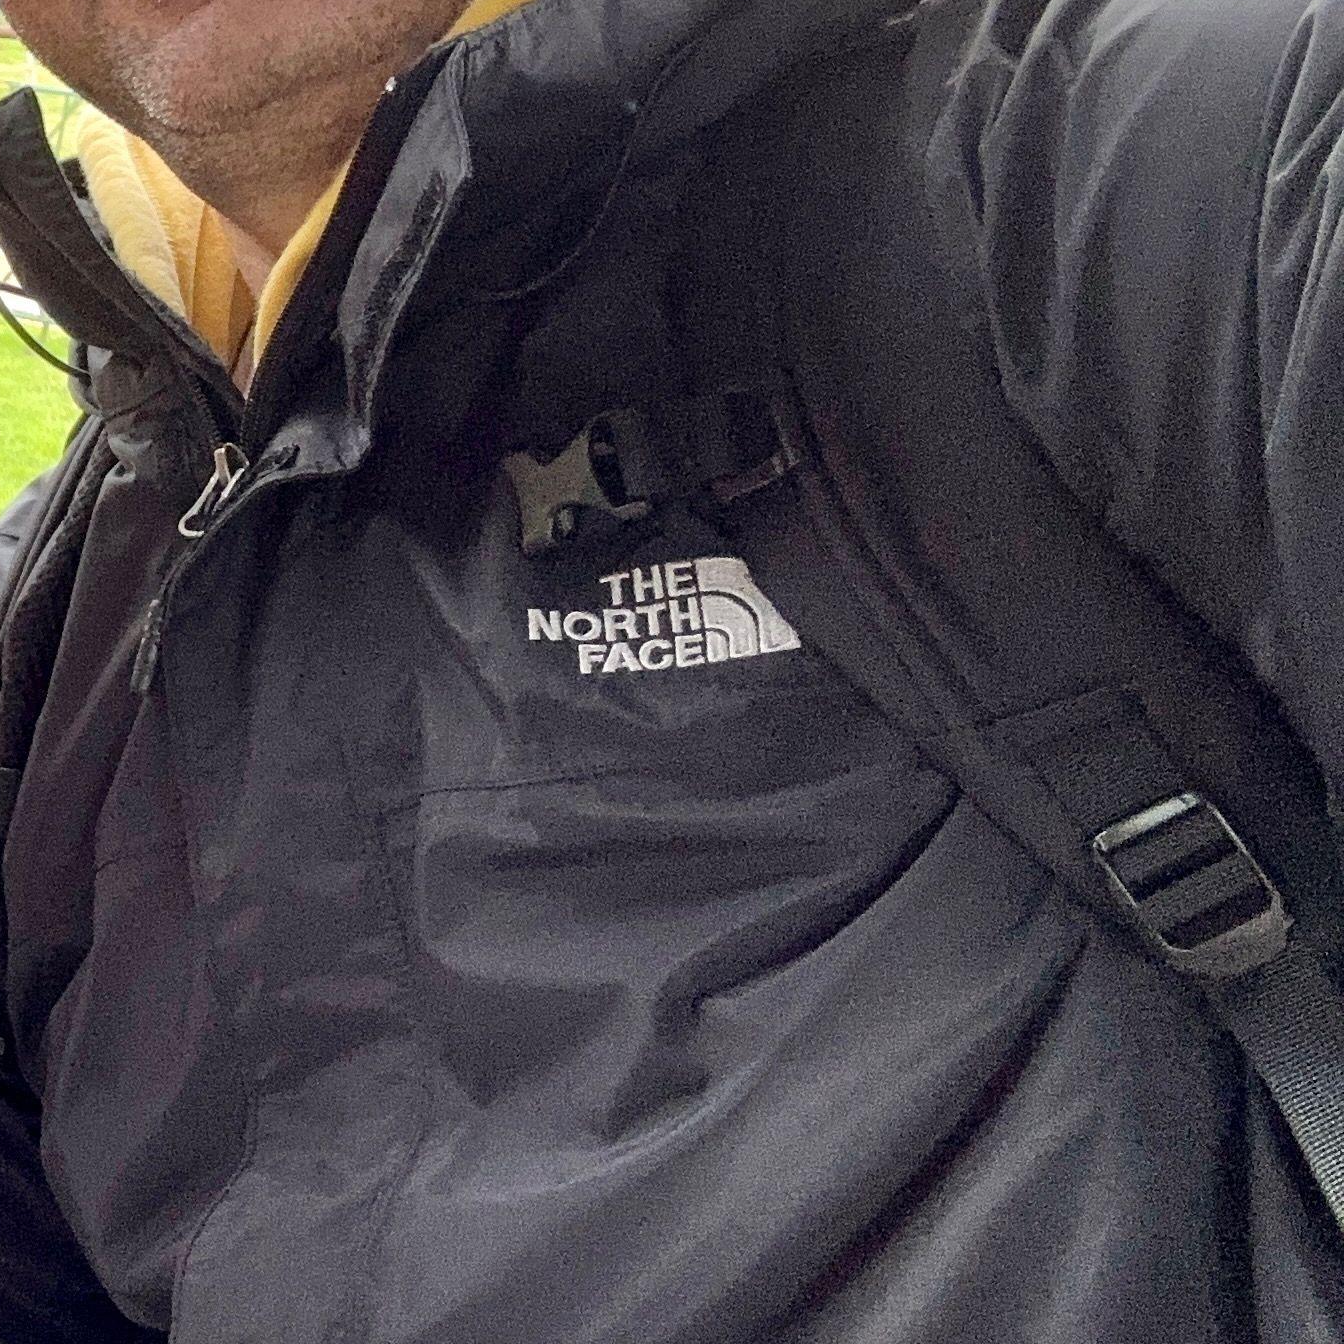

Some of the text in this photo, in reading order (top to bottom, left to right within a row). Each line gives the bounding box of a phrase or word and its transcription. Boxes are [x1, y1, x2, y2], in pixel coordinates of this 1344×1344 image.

[599, 560, 697, 606] THE
[526, 596, 703, 643] NORTH
[576, 631, 706, 675] FACE
